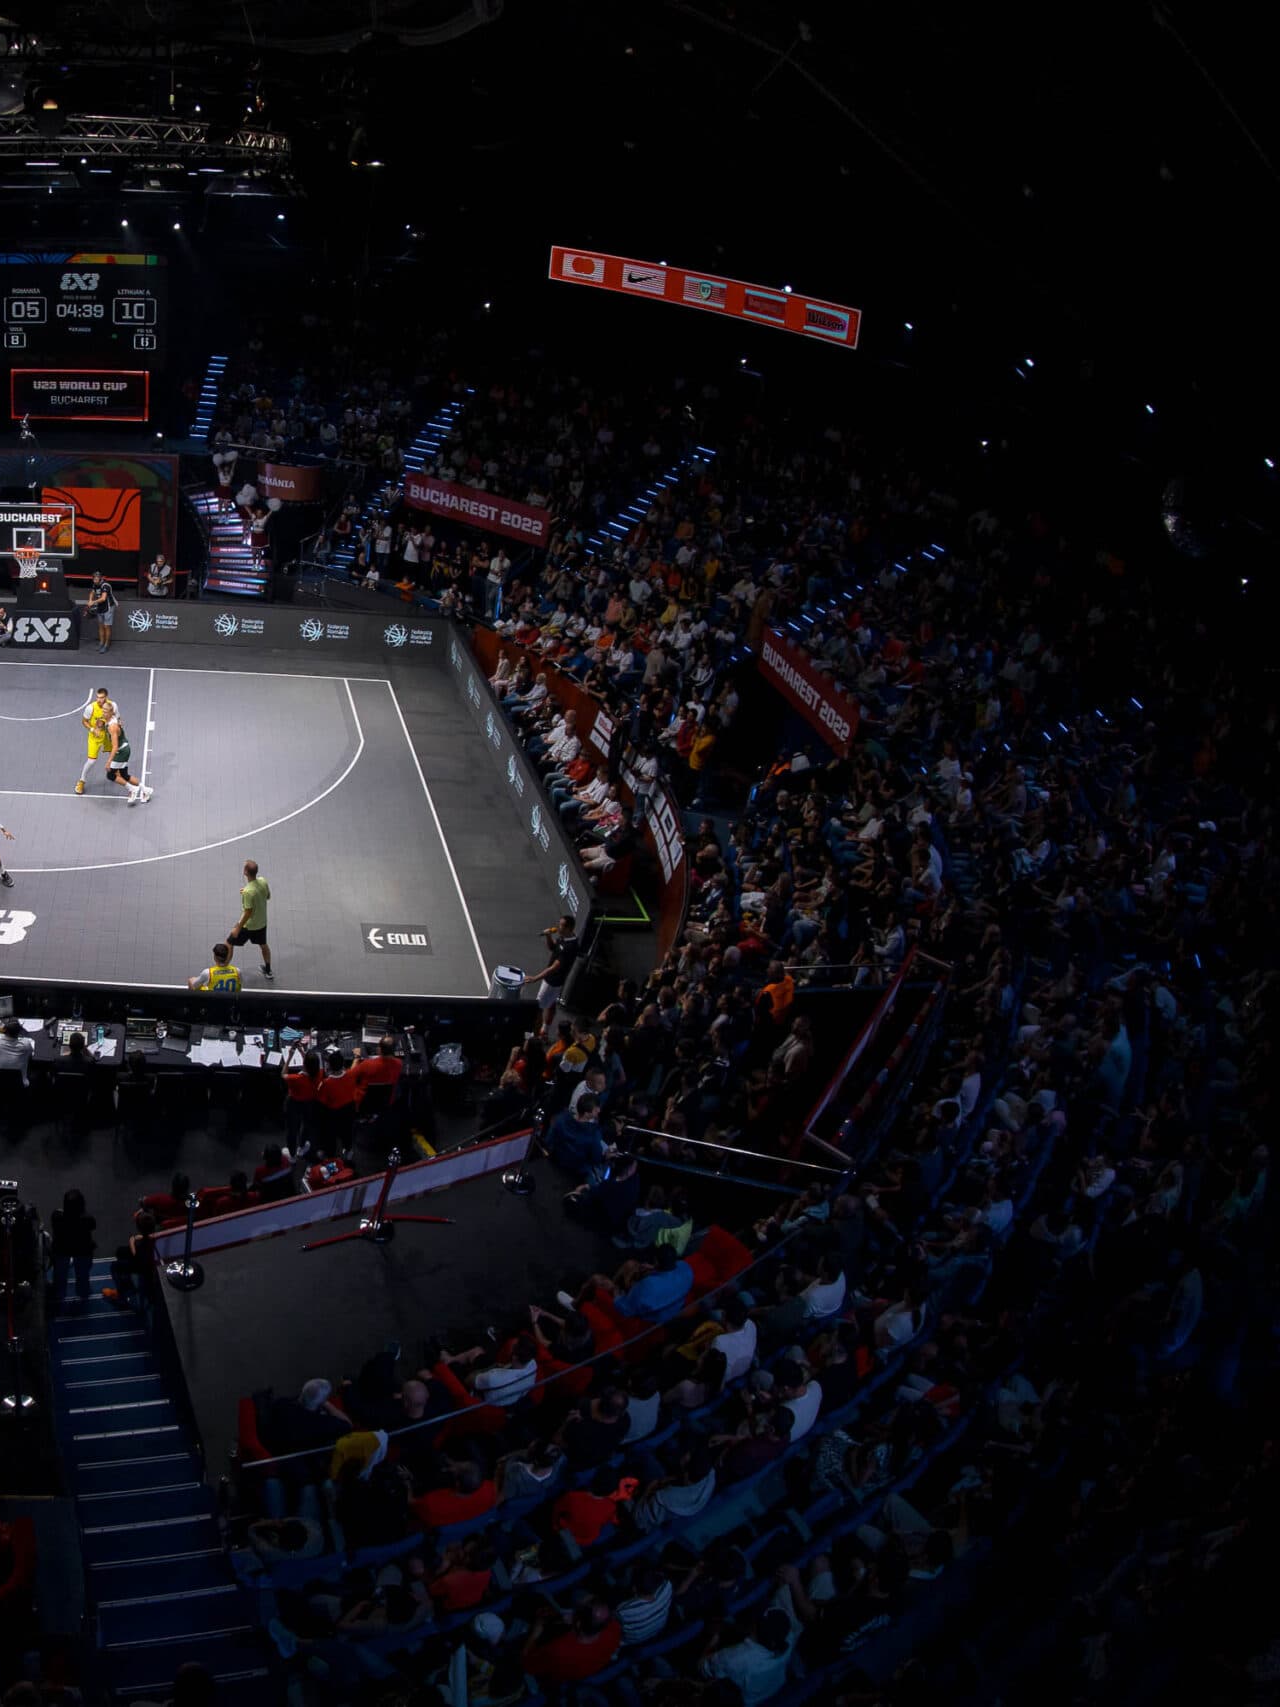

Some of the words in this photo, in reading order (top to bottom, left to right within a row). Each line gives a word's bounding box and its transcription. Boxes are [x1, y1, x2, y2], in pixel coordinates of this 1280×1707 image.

[11, 301, 40, 318] 05
[56, 303, 105, 318] 04:39
[121, 302, 145, 319] 10
[11, 335, 20, 345] 8
[32, 380, 57, 390] U23
[59, 381, 101, 391] WORLD
[103, 382, 128, 391] CUP
[50, 395, 109, 405] BUCHAREST
[410, 484, 499, 521] BUCHAREST
[500, 510, 543, 536] 2022
[762, 641, 821, 711] BUCHAREST
[818, 699, 850, 742] 2022
